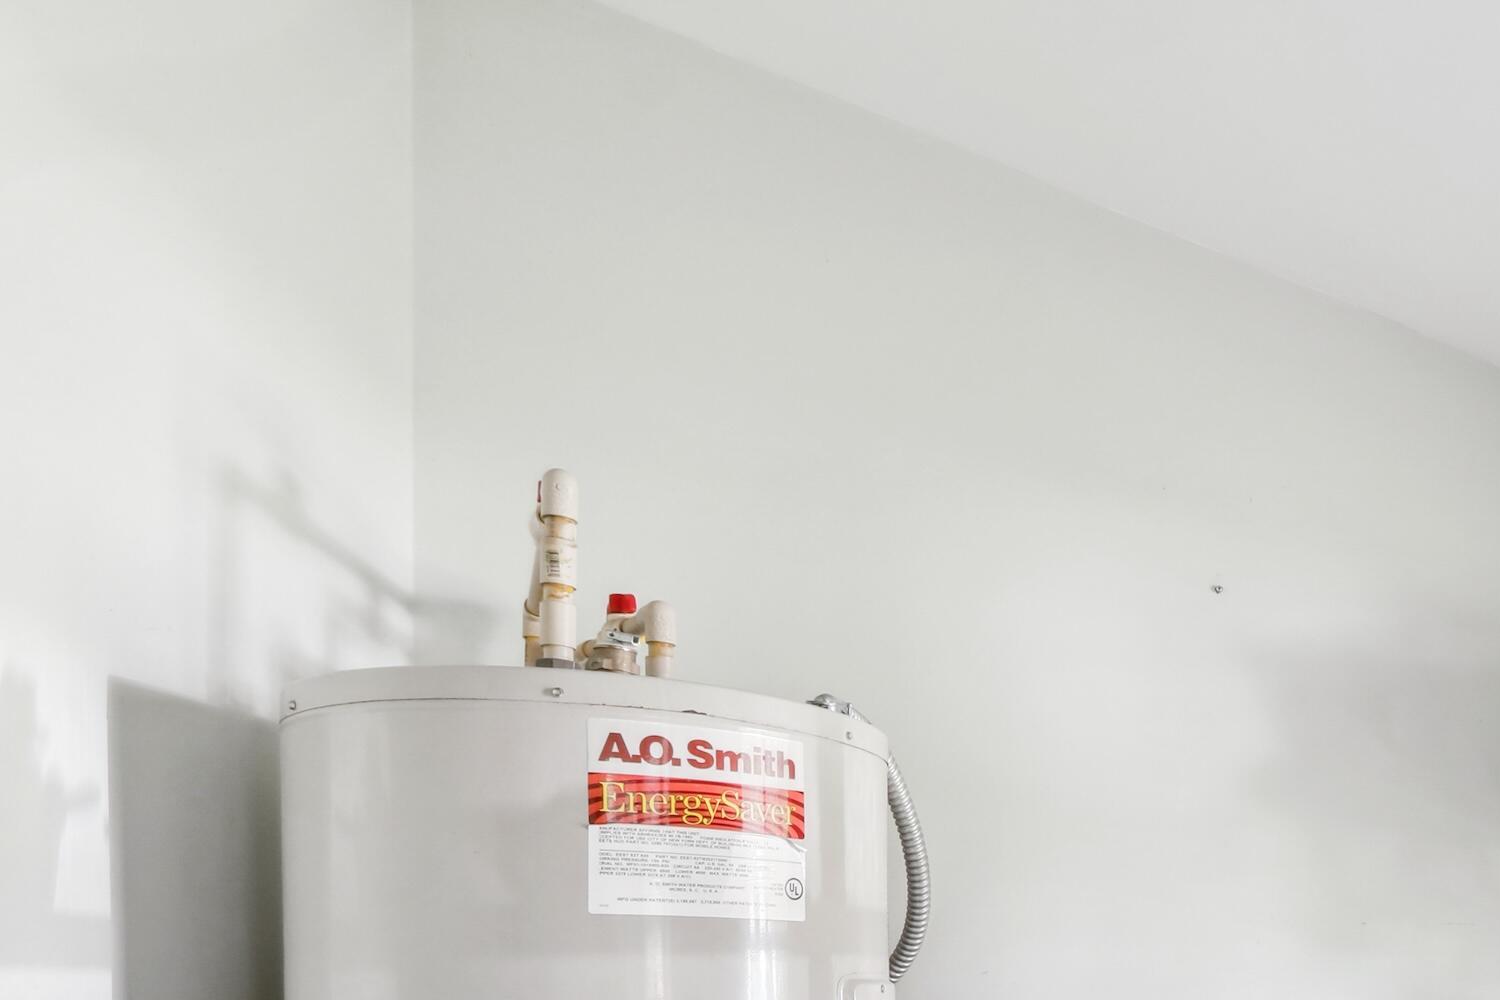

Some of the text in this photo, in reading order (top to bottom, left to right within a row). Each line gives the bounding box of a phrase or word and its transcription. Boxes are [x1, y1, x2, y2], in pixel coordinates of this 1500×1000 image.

[598, 731, 796, 780] A.O. Smith
[599, 781, 797, 826] EnergySaver
